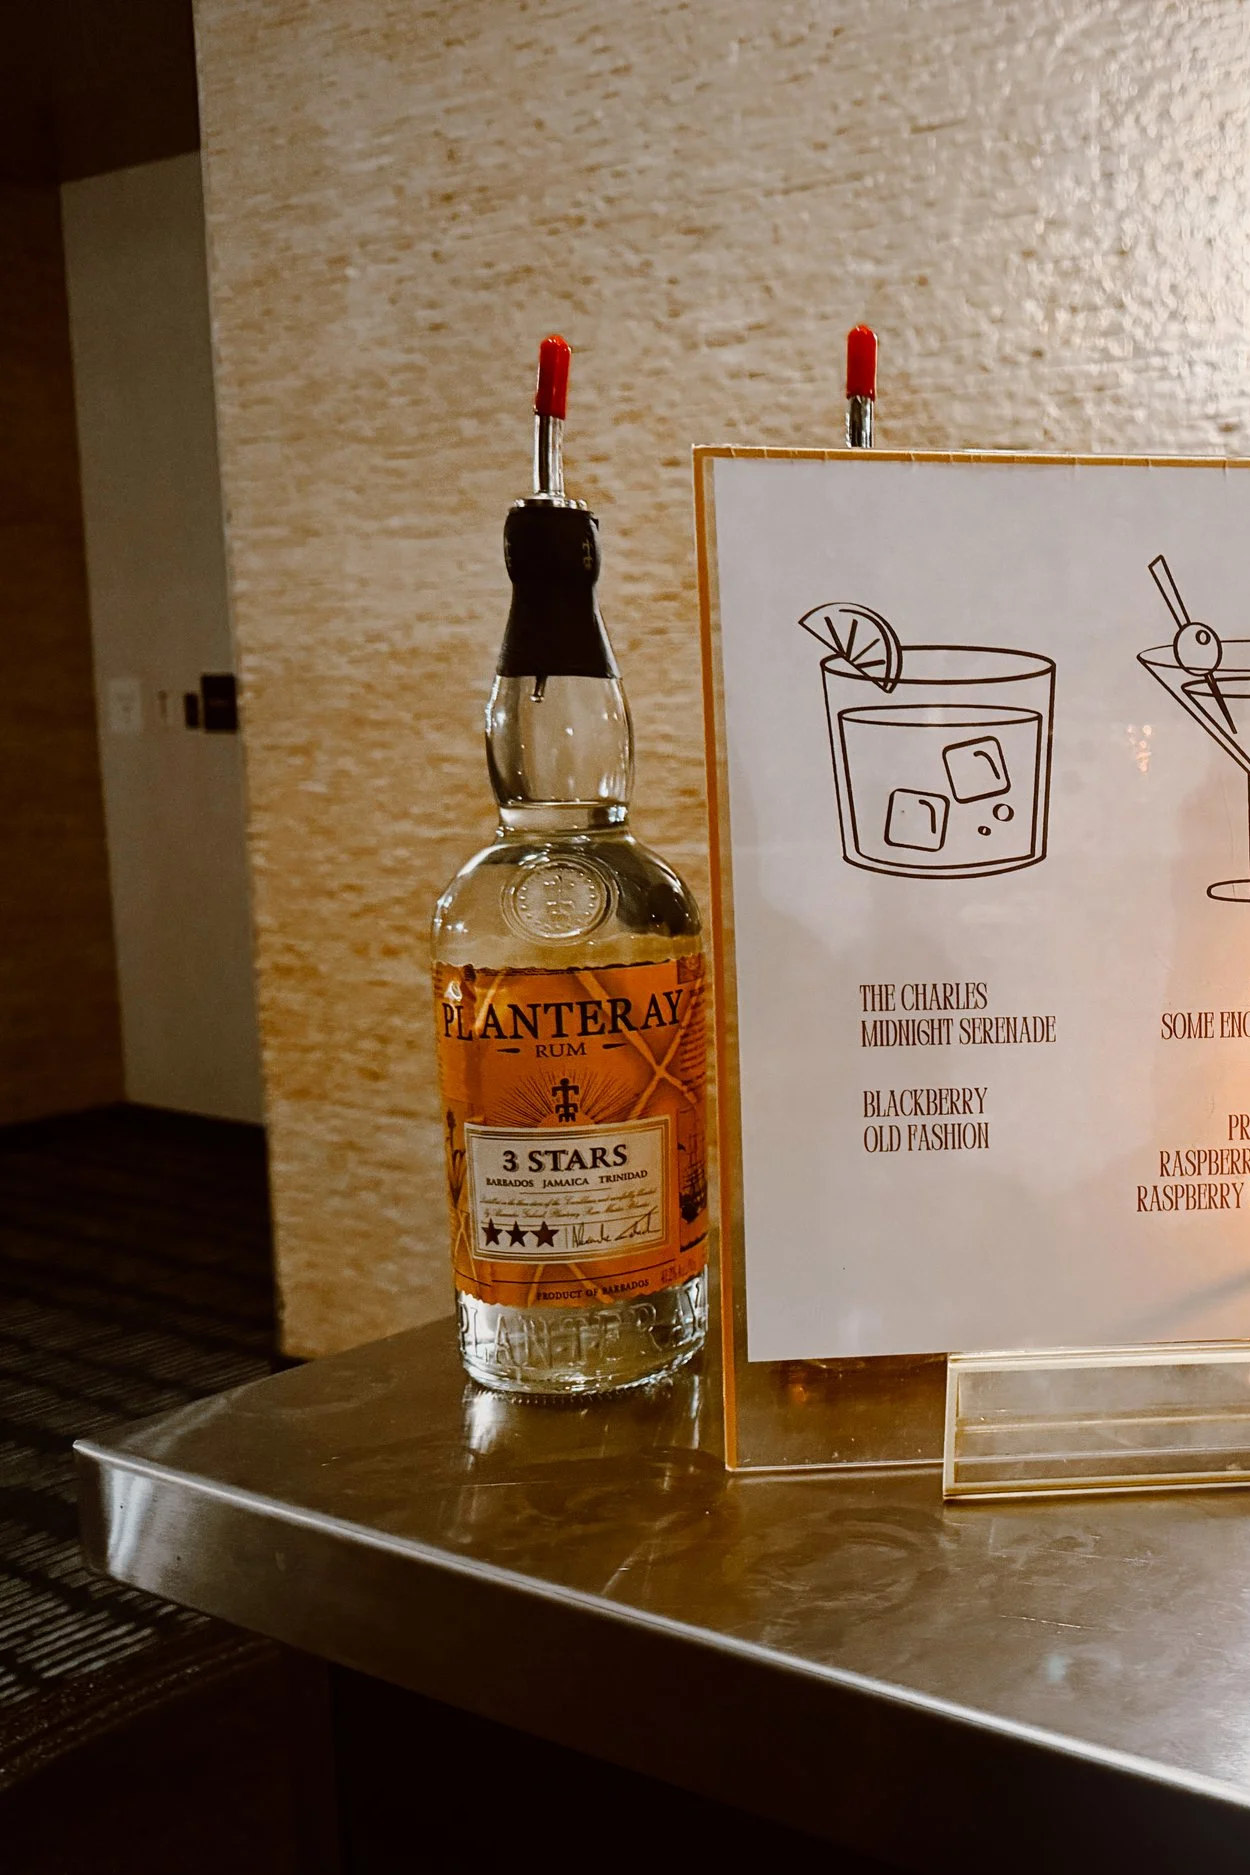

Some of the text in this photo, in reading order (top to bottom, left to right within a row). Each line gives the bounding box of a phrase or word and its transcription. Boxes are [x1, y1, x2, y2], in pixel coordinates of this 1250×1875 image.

[860, 982, 988, 1012] THE CHARLES
[443, 989, 683, 1041] PLANTERAY
[1161, 1012, 1214, 1040] SOME
[861, 1016, 1056, 1047] MIDNIGHT SERENADE
[535, 1042, 586, 1058] RUM
[863, 1087, 988, 1118] BLACKBERRY
[864, 1122, 990, 1153] OLD FASHION
[503, 1144, 627, 1172] 3 STARS
[486, 1169, 648, 1188] BARBADOS JAMAICA TRINIDAD
[1136, 1182, 1244, 1212] RASPBERRY
[537, 1280, 649, 1301] PRODUCT OF BARBADOS
